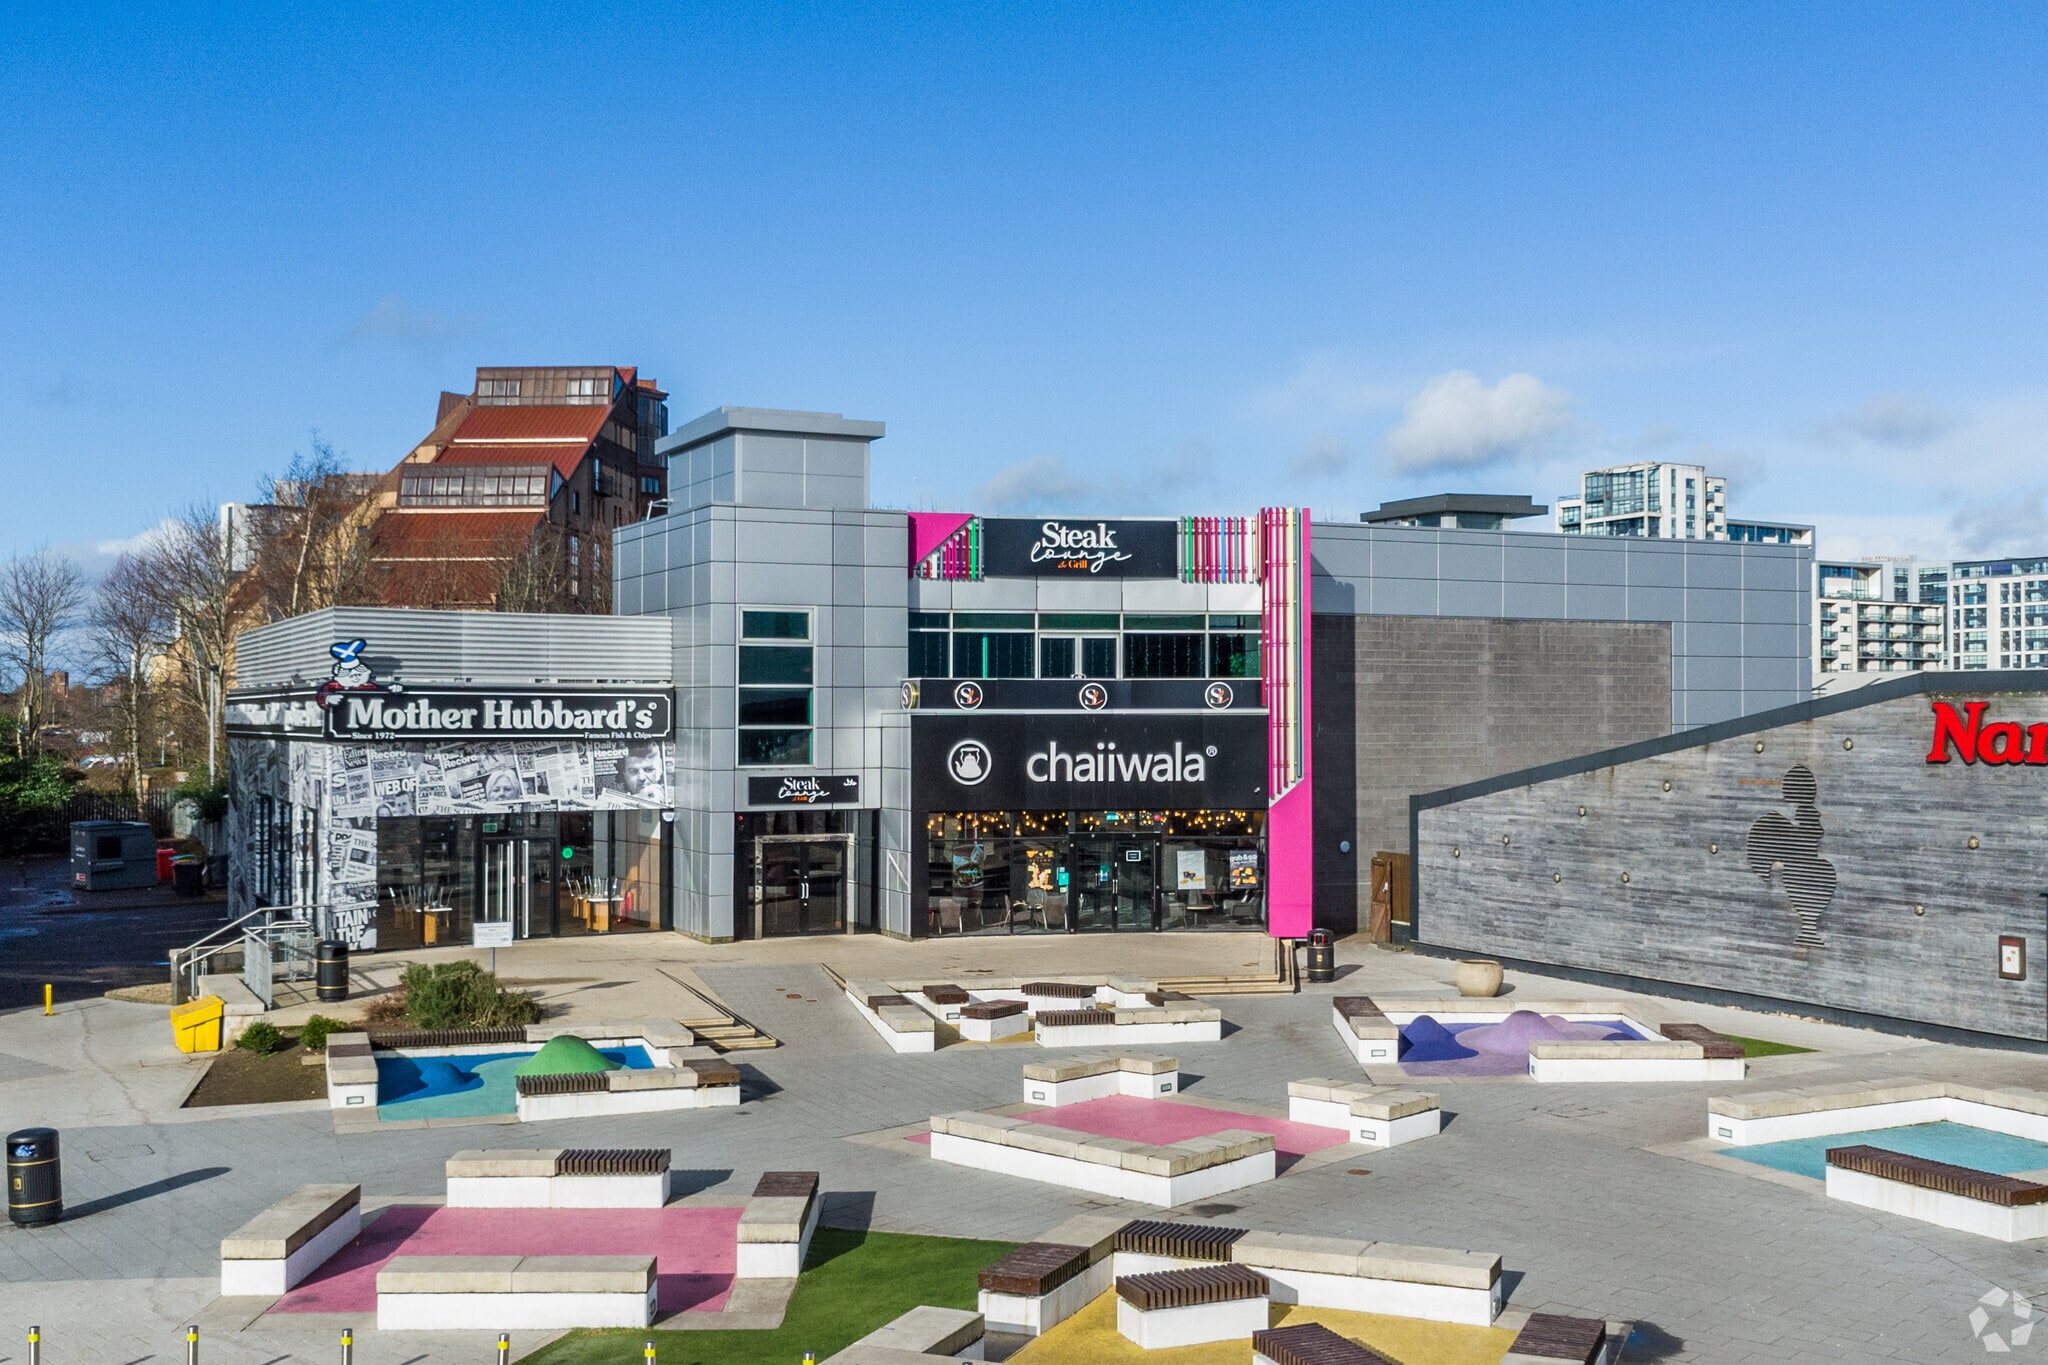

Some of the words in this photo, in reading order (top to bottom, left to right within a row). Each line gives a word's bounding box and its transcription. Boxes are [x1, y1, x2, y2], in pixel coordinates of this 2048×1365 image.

[1041, 521, 1118, 549] Steak
[1068, 559, 1088, 569] Grill
[347, 698, 478, 730] Mother
[483, 699, 654, 730] Hubbard's
[375, 732, 396, 740] 1972
[633, 732, 653, 740] Chips
[594, 747, 629, 758] Record
[444, 755, 478, 769] Record
[374, 780, 401, 797] WEB
[401, 777, 417, 793] OF
[783, 776, 821, 791] Steak
[354, 838, 371, 848] THE
